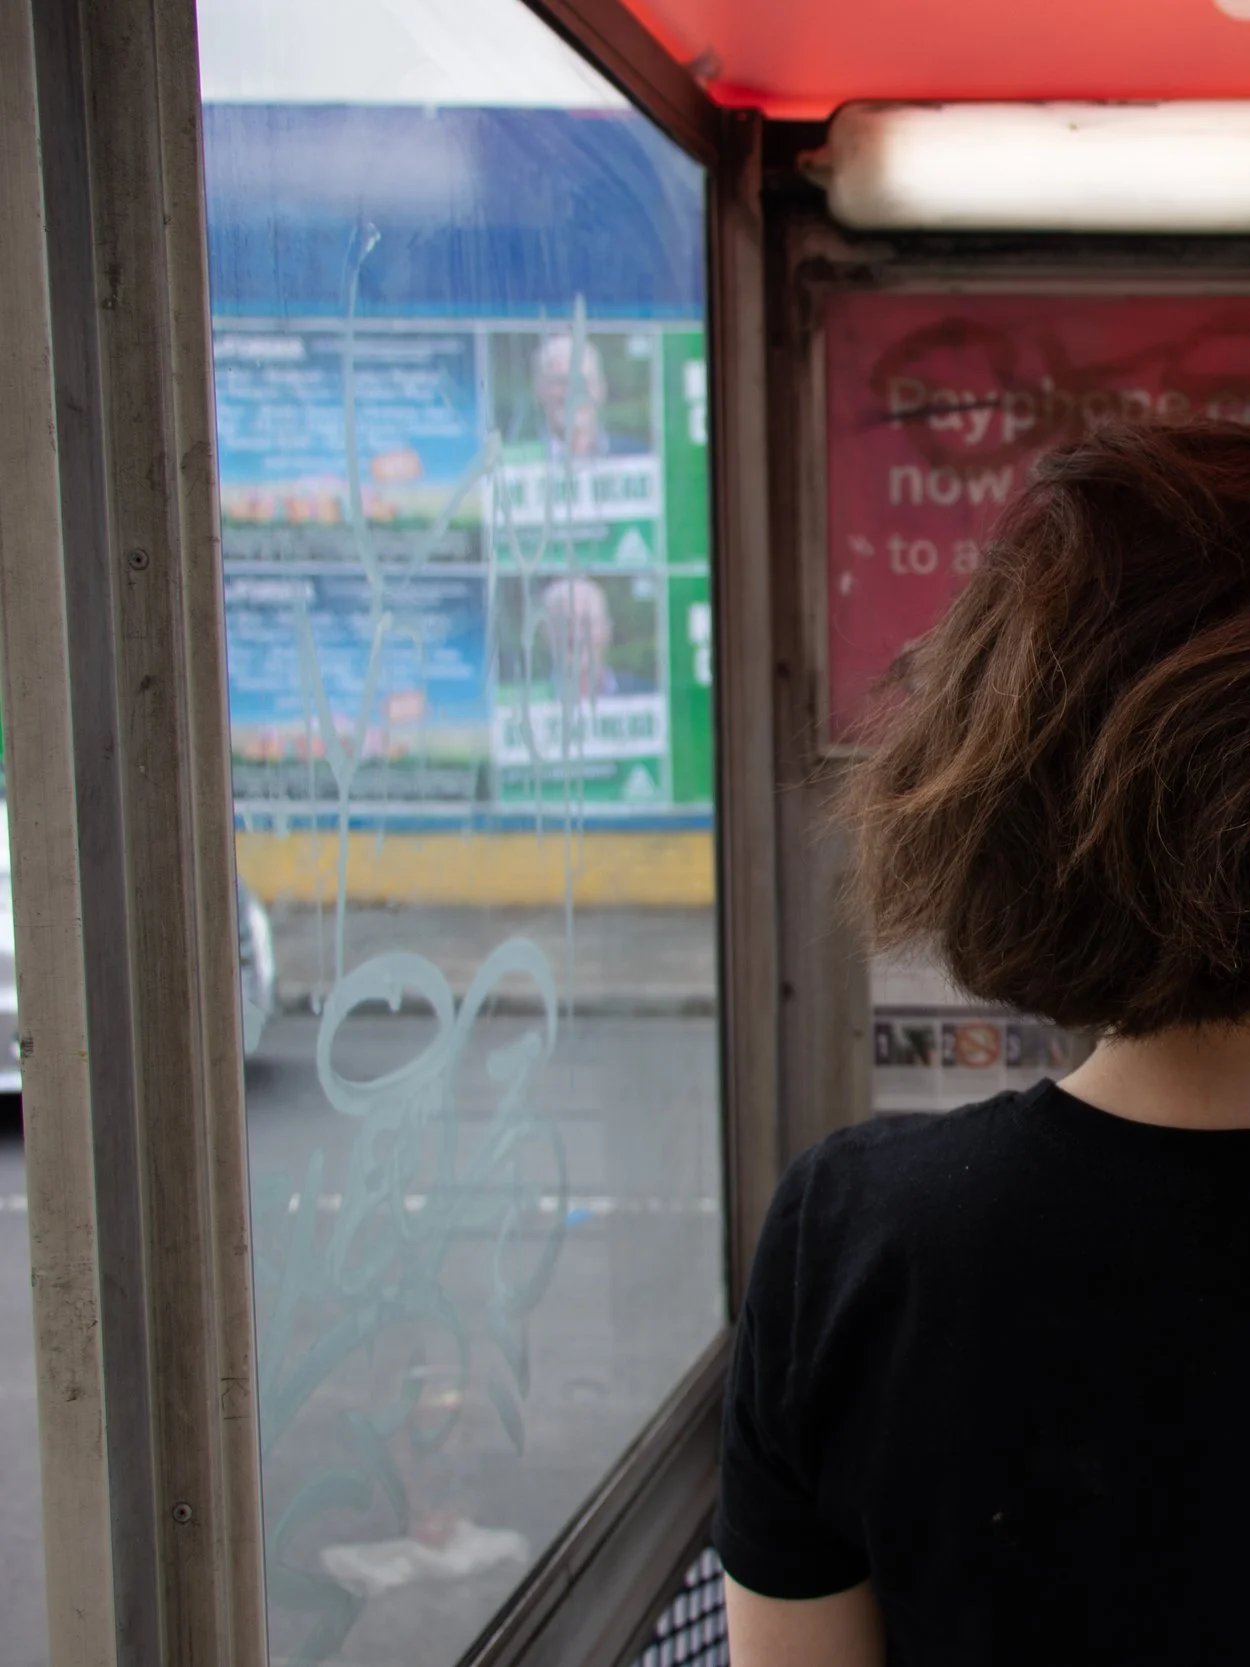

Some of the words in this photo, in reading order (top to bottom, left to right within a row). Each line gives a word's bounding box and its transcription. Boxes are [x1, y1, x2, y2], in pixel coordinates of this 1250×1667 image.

[888, 375, 1192, 444] Payphone
[889, 463, 1014, 506] now
[889, 533, 939, 576] to
